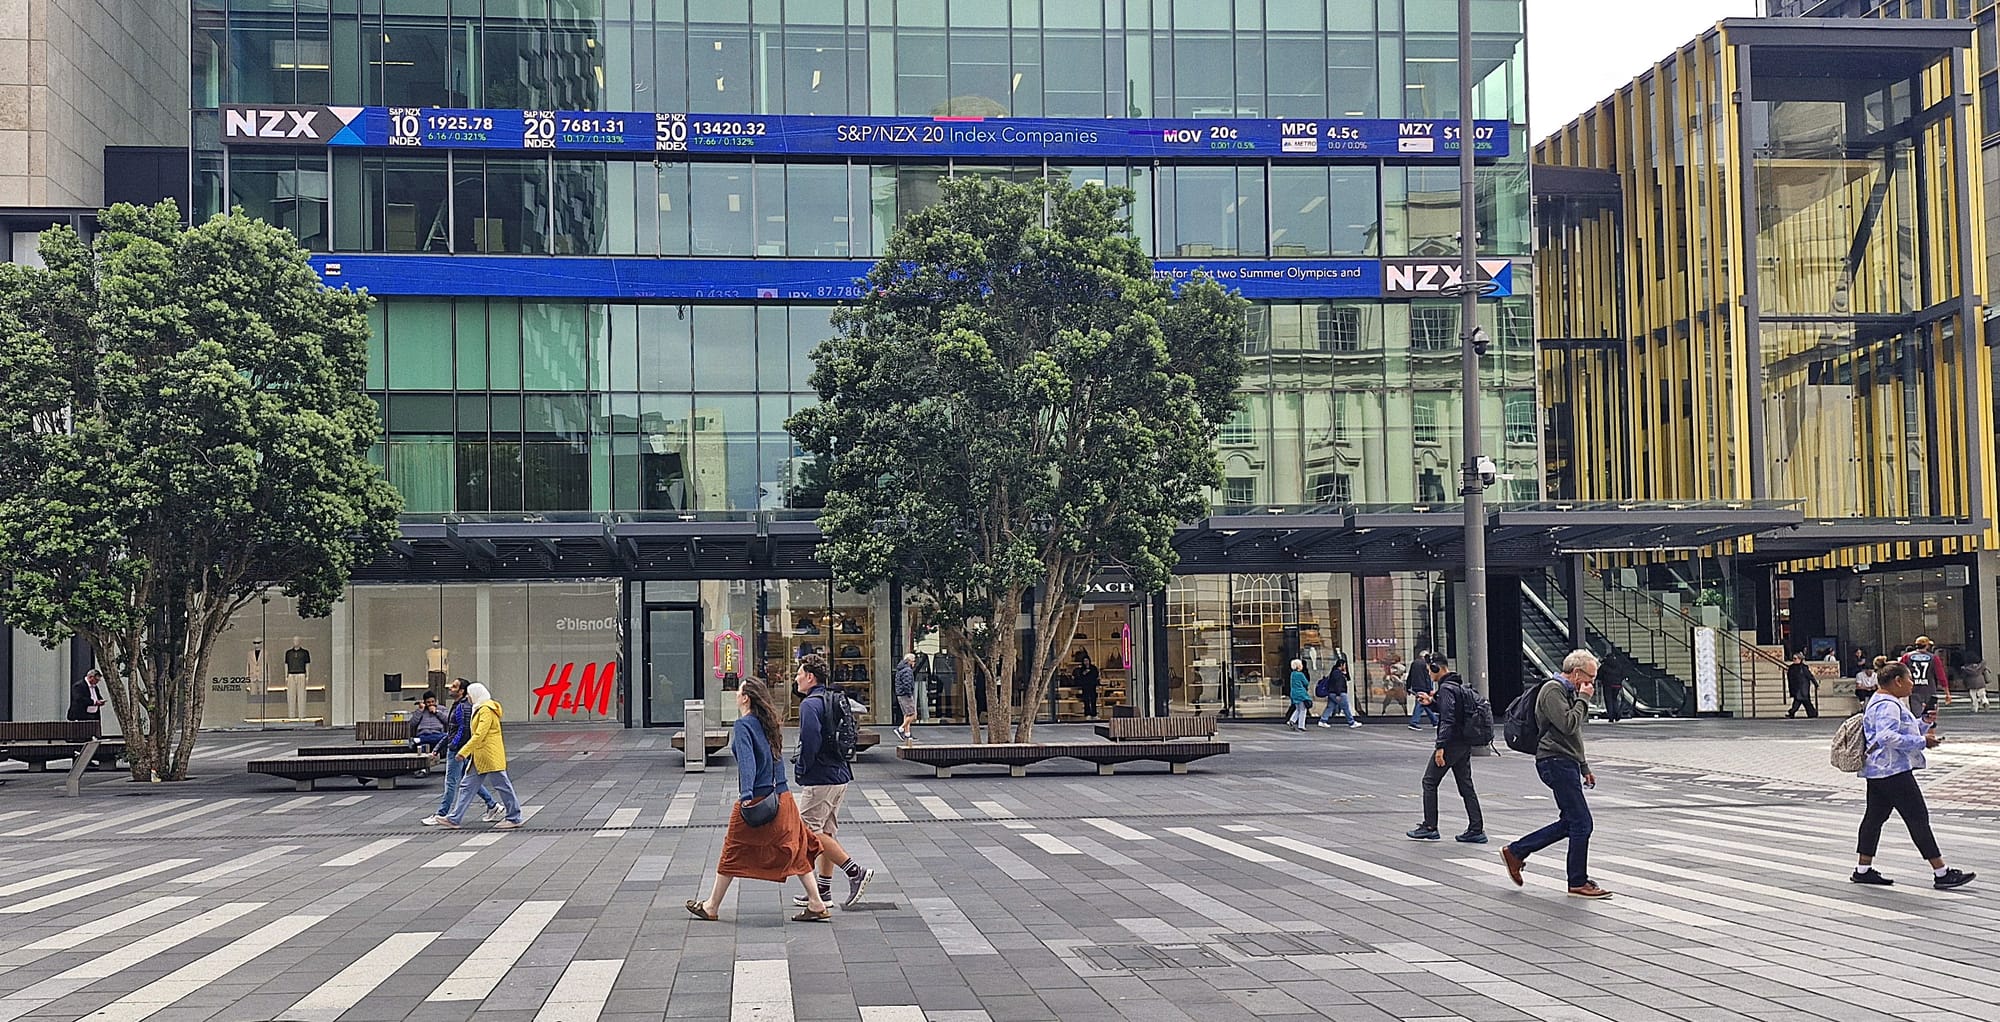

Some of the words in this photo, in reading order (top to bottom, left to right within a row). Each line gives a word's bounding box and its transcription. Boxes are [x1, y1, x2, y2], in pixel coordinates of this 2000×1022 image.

[405, 108, 421, 116] NZX
[540, 111, 555, 119] NZX
[671, 113, 687, 121] NZX
[226, 109, 320, 139] NZX
[392, 116, 419, 137] 10
[428, 117, 493, 130] 1925.78
[524, 119, 555, 139] 20
[561, 119, 624, 133] 7681.31
[693, 122, 766, 135] 13420.32
[1282, 123, 1317, 136] MPG
[1399, 123, 1434, 136] MZY
[455, 133, 487, 141] 0.321%
[656, 121, 687, 141] 50
[837, 125, 918, 143] S&P/NZX
[922, 126, 944, 142] 20
[950, 127, 996, 144] Index
[1001, 127, 1098, 148] Companies
[1163, 130, 1202, 143] MOV
[1210, 126, 1238, 139] 20¢
[1327, 127, 1359, 139] 4.5¢
[1444, 127, 1494, 139] $1.07
[389, 136, 421, 146] INDEX
[524, 139, 556, 148] INDEX
[593, 135, 625, 144] 0.133%
[656, 141, 687, 151] INDEX
[694, 137, 716, 145] 17.66
[724, 138, 755, 146] 0.132%
[1328, 141, 1341, 149] 0.0
[1348, 141, 1368, 149] 0.0%
[1172, 267, 1188, 278] for
[1217, 269, 1237, 278] two
[1240, 267, 1284, 278] Summer
[1287, 267, 1338, 281] Olympics
[1340, 267, 1361, 278] and
[1386, 265, 1462, 291] NZX
[212, 676, 229, 684] S/S
[230, 676, 252, 684] 2025
[532, 661, 617, 718] H&M
